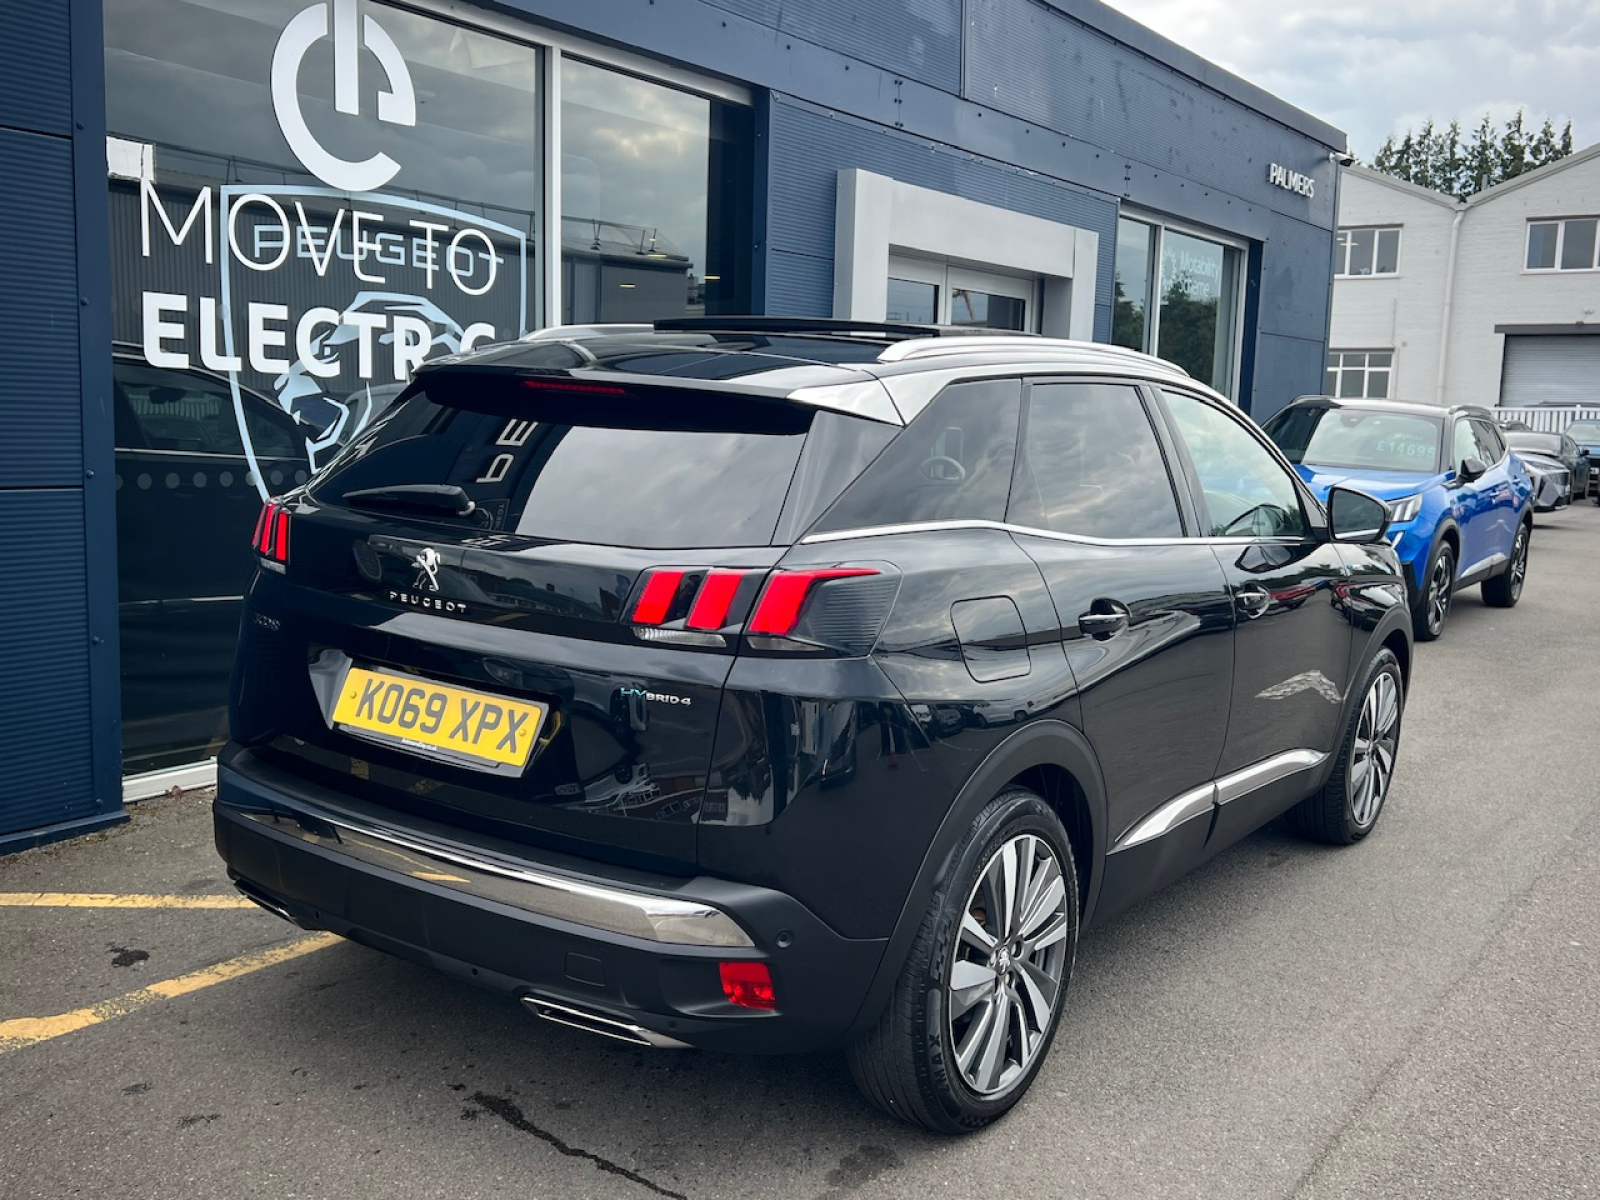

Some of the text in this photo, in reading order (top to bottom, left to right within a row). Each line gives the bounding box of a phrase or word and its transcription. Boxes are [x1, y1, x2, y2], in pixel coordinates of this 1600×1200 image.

[1269, 162, 1316, 199] PALMERS
[140, 177, 497, 296] MOVE TO
[253, 224, 504, 278] PEUGEOT
[389, 590, 467, 614] PEUGEOT
[448, 698, 530, 754] XPX
